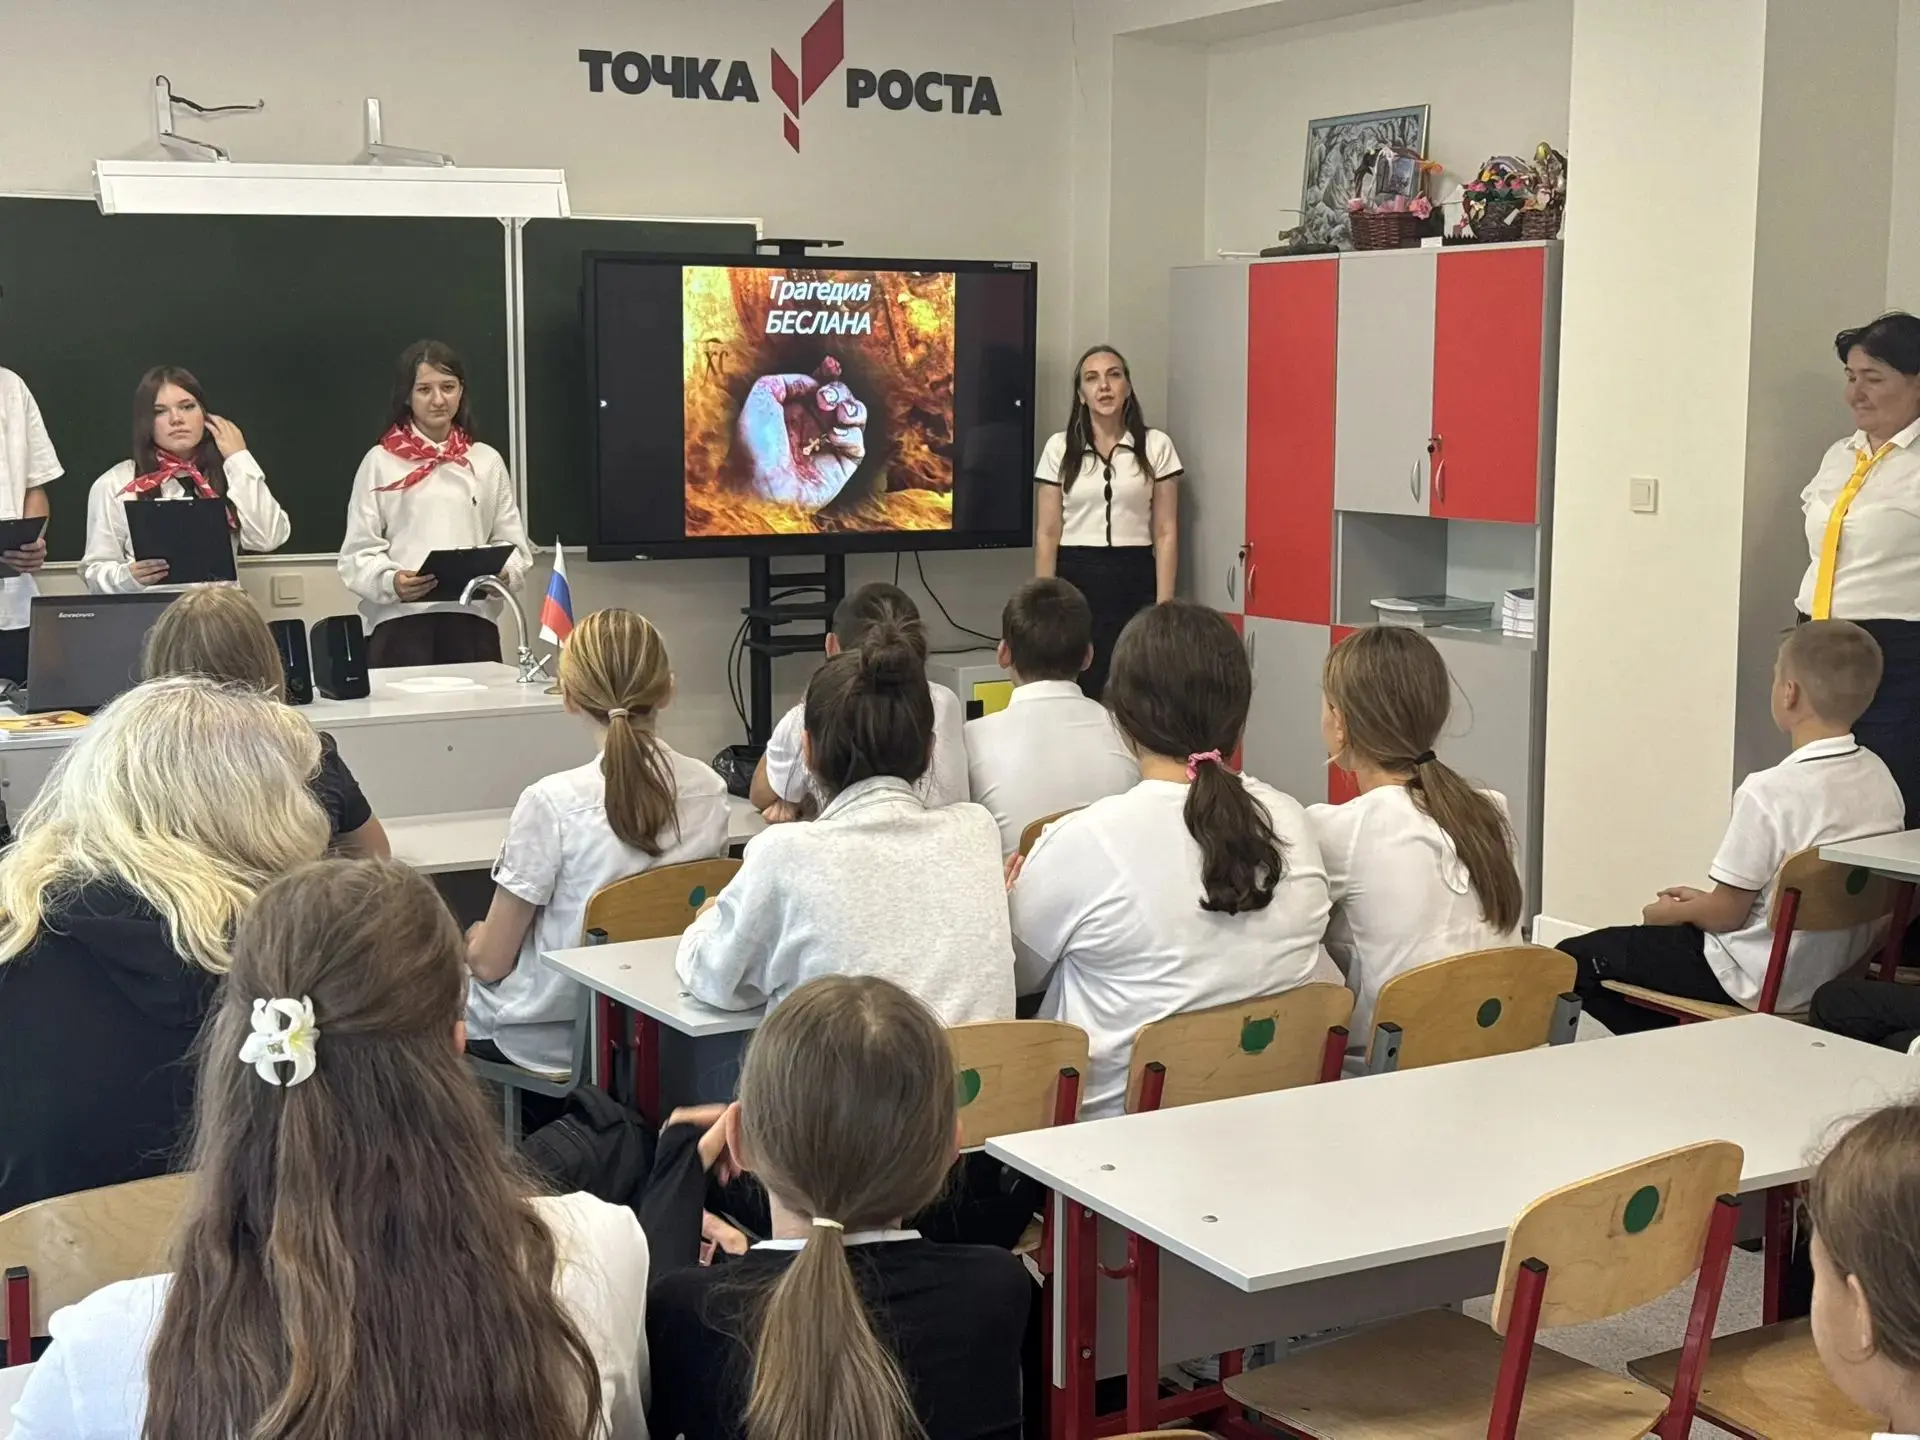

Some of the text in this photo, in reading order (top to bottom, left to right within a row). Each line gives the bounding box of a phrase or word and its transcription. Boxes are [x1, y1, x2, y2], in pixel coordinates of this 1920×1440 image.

[579, 49, 1002, 116] ТОЧКА РОСТА
[768, 275, 872, 306] Трагедия
[765, 310, 872, 335] БЕСЛАНА
